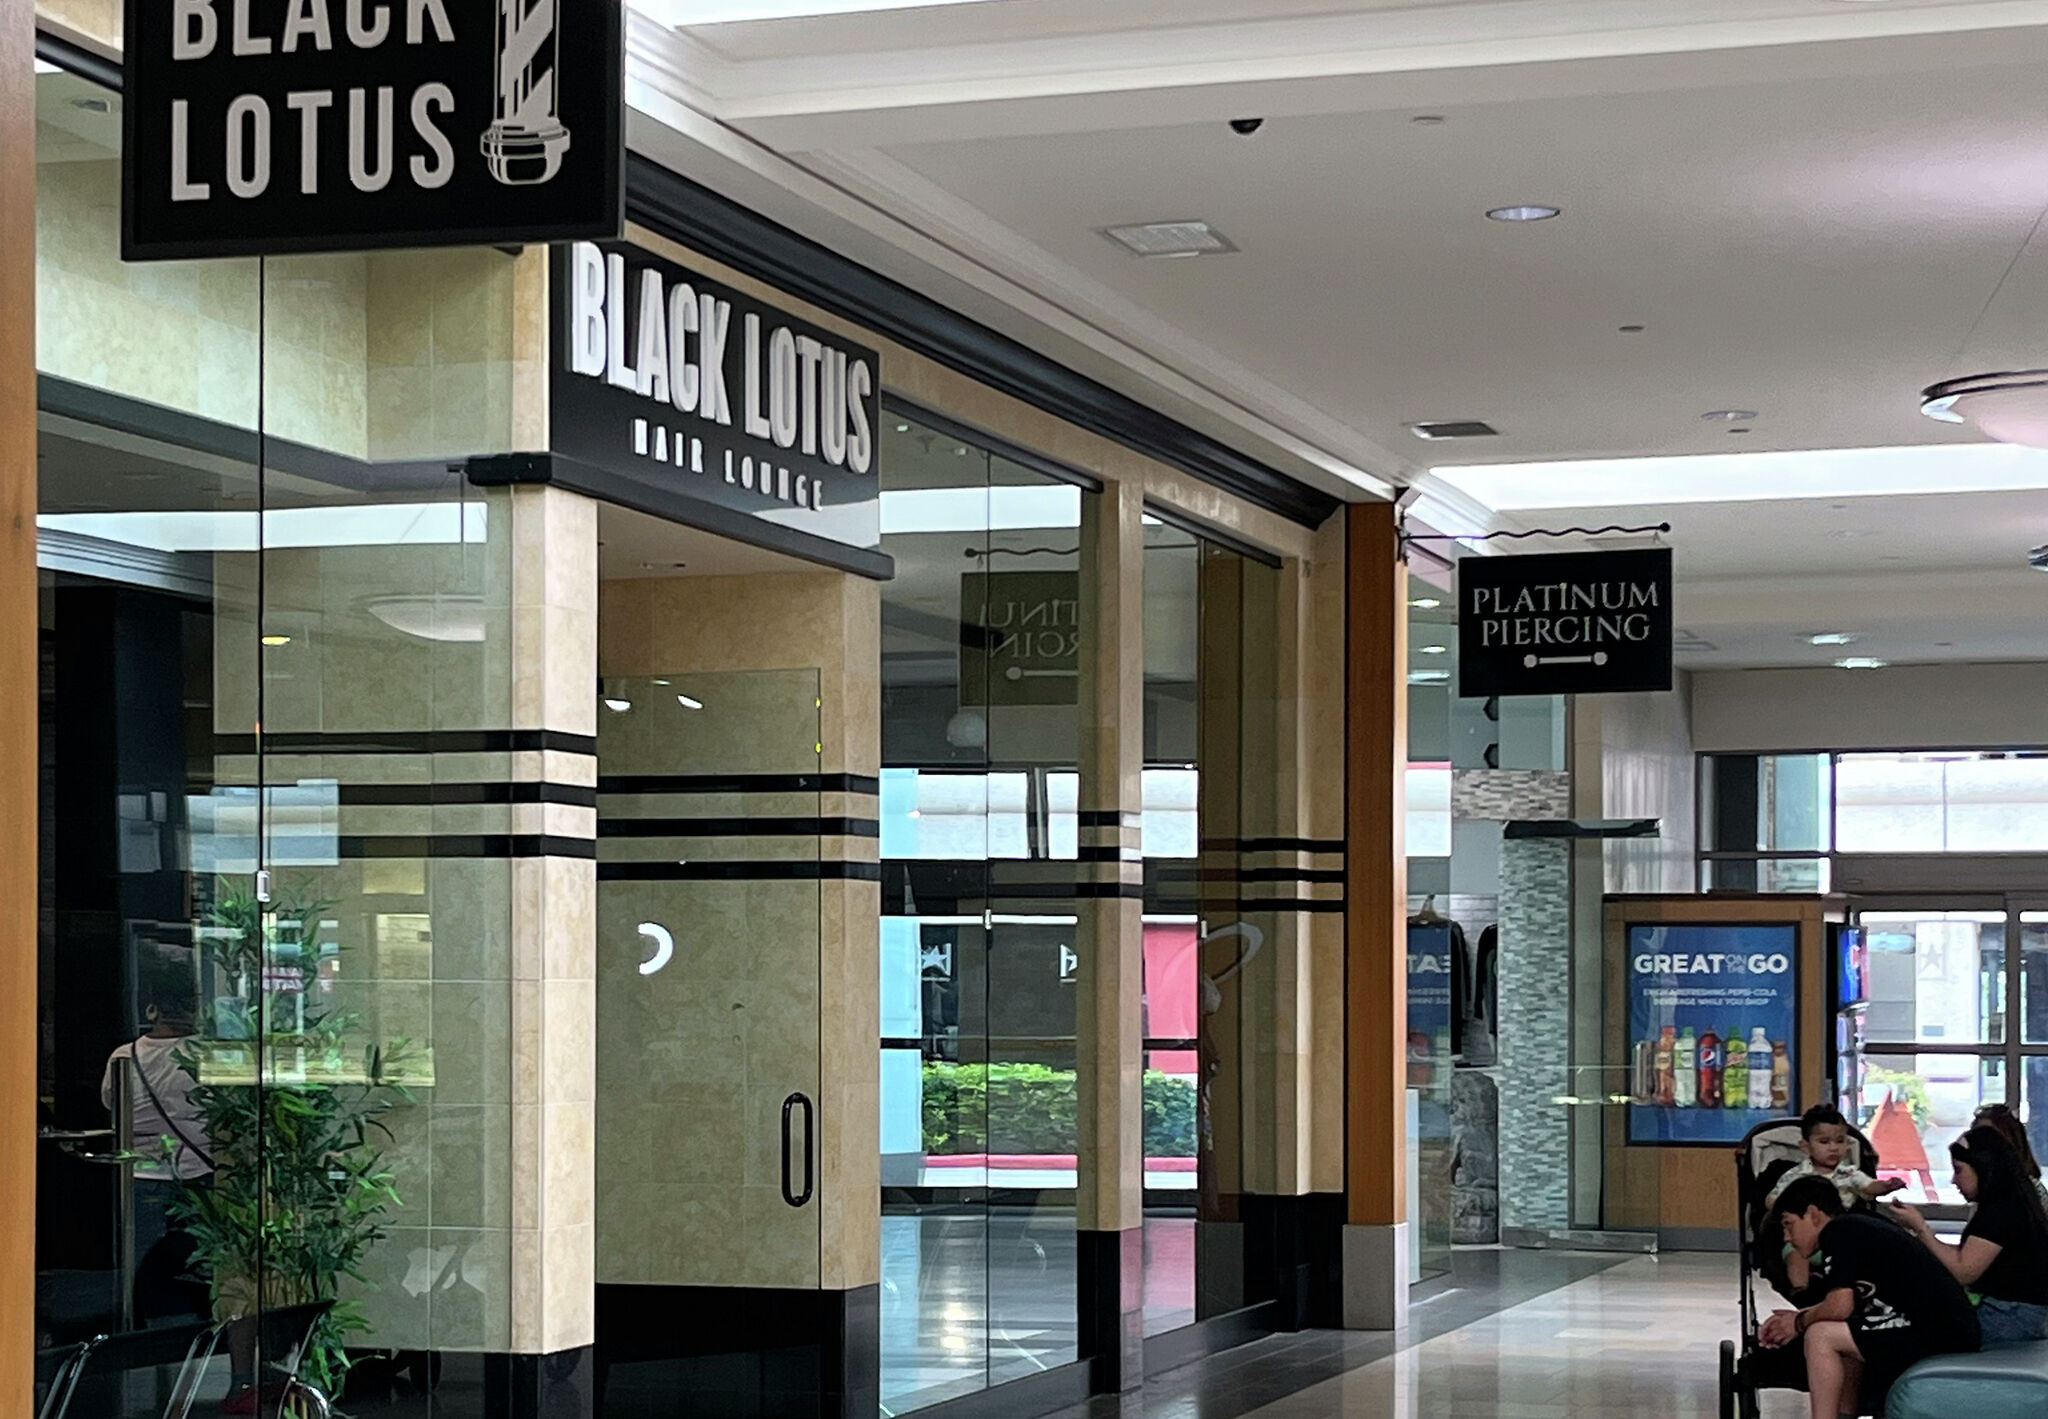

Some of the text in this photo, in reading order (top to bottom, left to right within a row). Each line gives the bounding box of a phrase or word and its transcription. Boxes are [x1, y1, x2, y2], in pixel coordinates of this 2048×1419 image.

[171, 82, 455, 202] LOTUS
[569, 241, 872, 475] BLACK LOTUS
[631, 418, 824, 513] HAIR LOUNGE
[1473, 581, 1660, 615] PLATINUM
[1482, 614, 1651, 647] PIERCING
[1634, 953, 1725, 974] GREAT
[1747, 953, 1789, 974] GO
